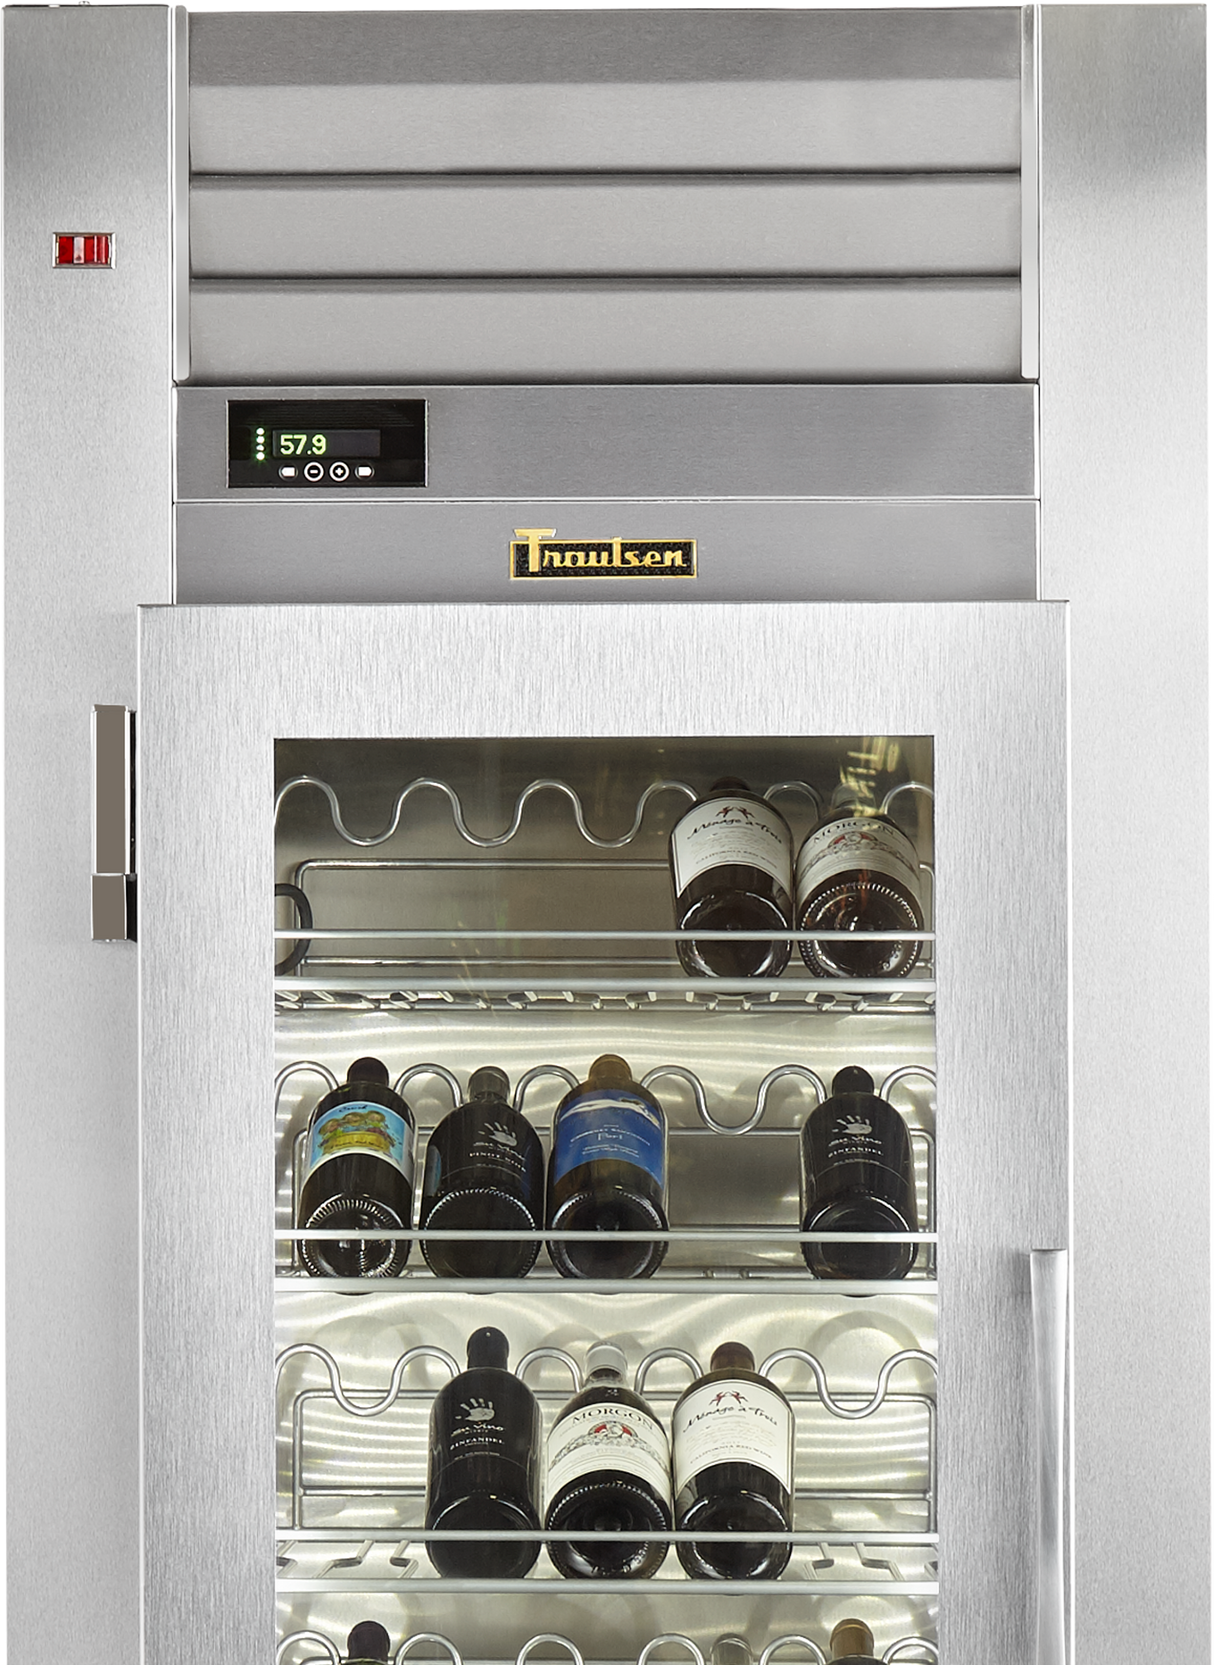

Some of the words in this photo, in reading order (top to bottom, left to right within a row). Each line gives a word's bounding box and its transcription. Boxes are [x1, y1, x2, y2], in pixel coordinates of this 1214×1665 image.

[280, 434, 327, 455] 57.9
[514, 528, 687, 573] Traulsen
[813, 821, 894, 843] MORGON
[573, 1408, 652, 1430] MORGON
[450, 1437, 505, 1450] ZINFANDEL
